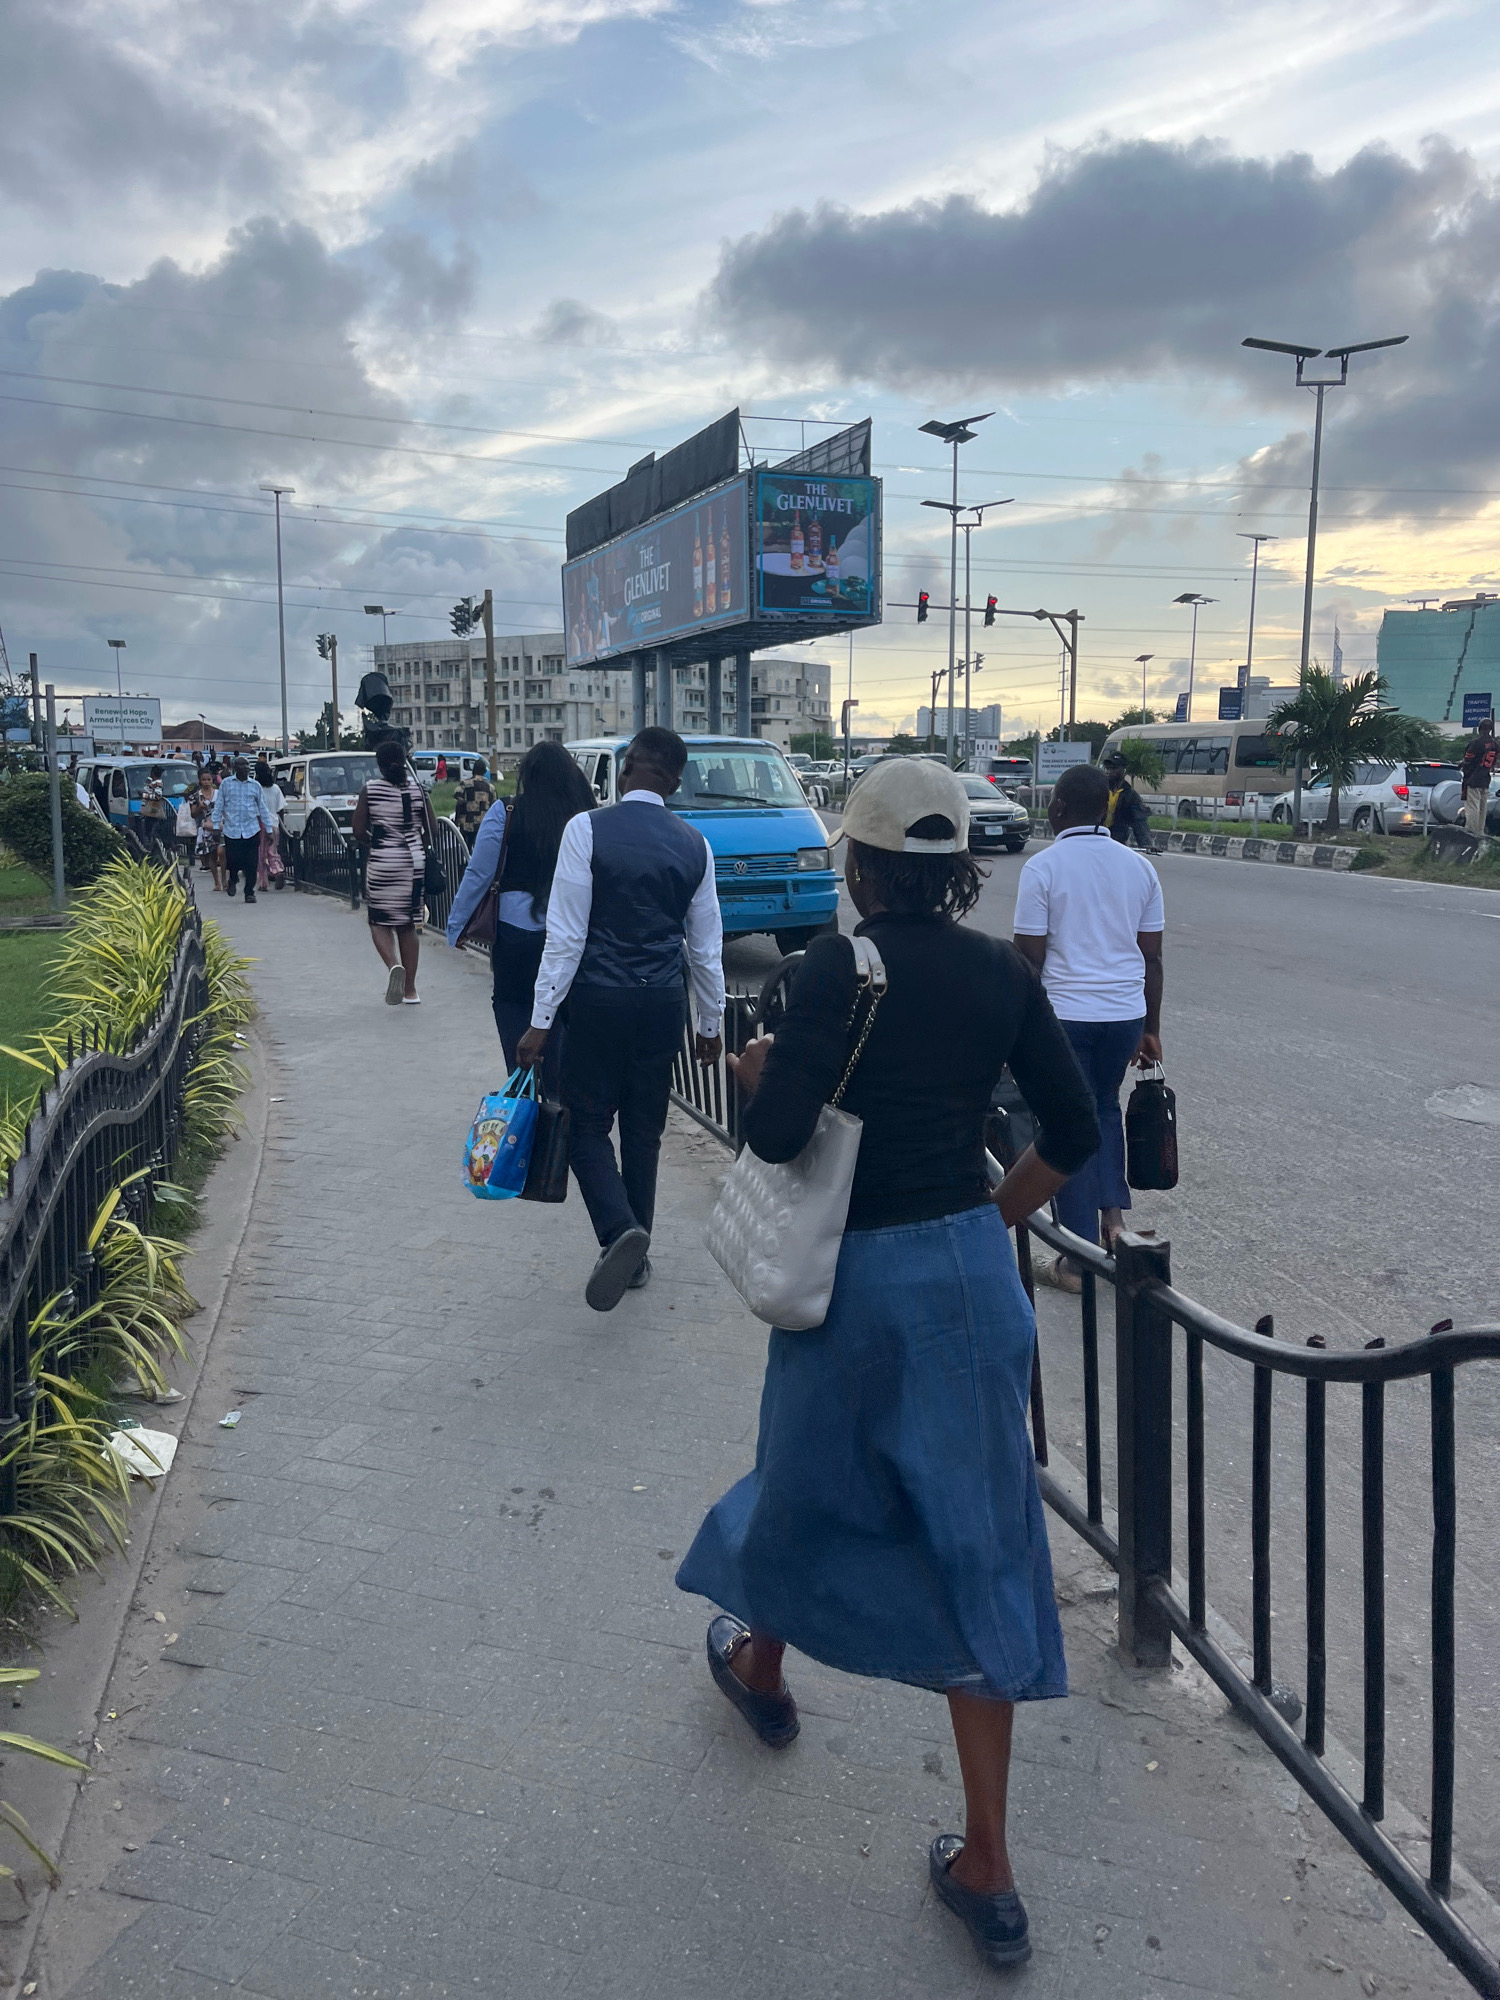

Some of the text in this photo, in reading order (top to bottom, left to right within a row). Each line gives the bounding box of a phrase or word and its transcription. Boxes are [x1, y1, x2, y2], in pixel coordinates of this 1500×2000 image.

[805, 483, 827, 495] THE
[776, 494, 854, 515] GLENLIVET
[639, 545, 653, 569] THE
[624, 561, 671, 607] GLENLIVET
[640, 606, 662, 623] ORIGINAL
[89, 716, 114, 724] Armed
[139, 717, 155, 726] City
[129, 708, 148, 717] Hope
